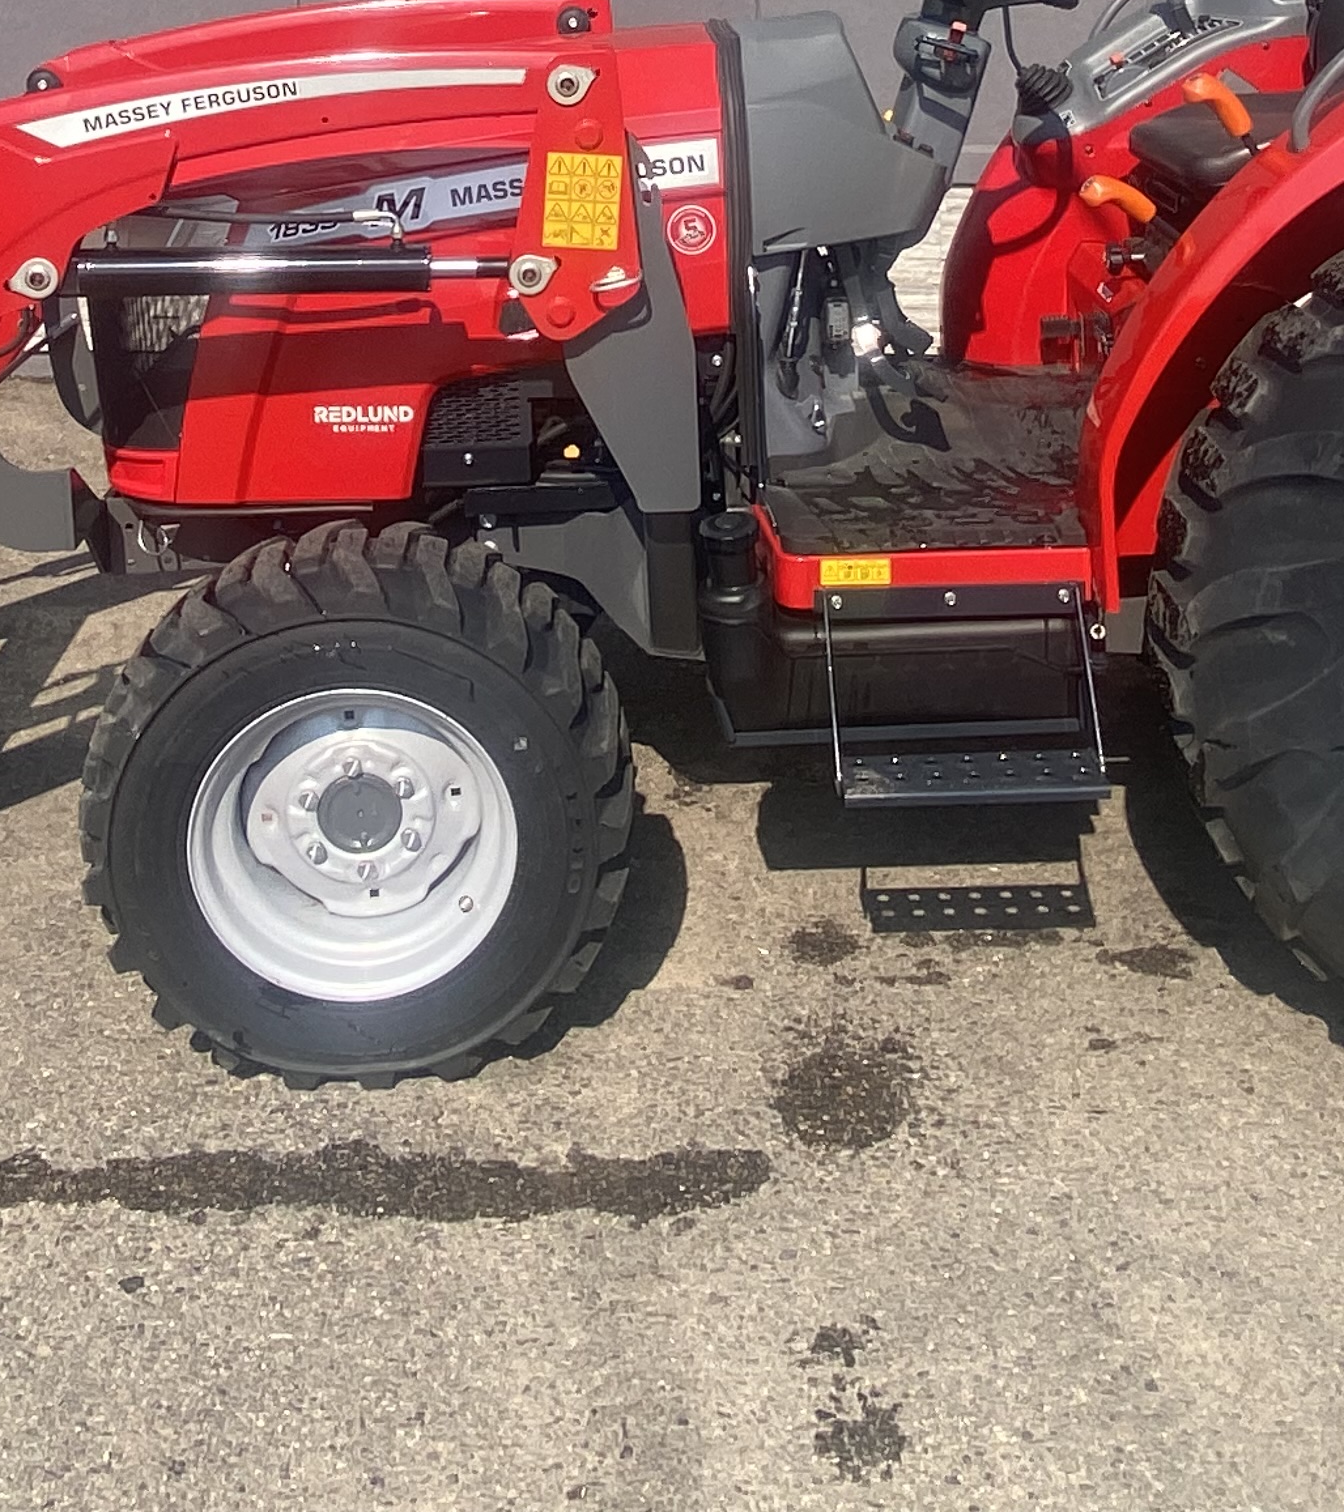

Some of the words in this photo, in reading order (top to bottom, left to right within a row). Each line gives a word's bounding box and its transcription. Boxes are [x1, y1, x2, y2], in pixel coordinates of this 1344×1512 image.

[82, 100, 172, 133] MASSEY
[181, 81, 298, 113] FERGUSON
[449, 178, 524, 207] MASS
[313, 405, 414, 423] REDLUND
[332, 424, 396, 433] EQUIPMENT
